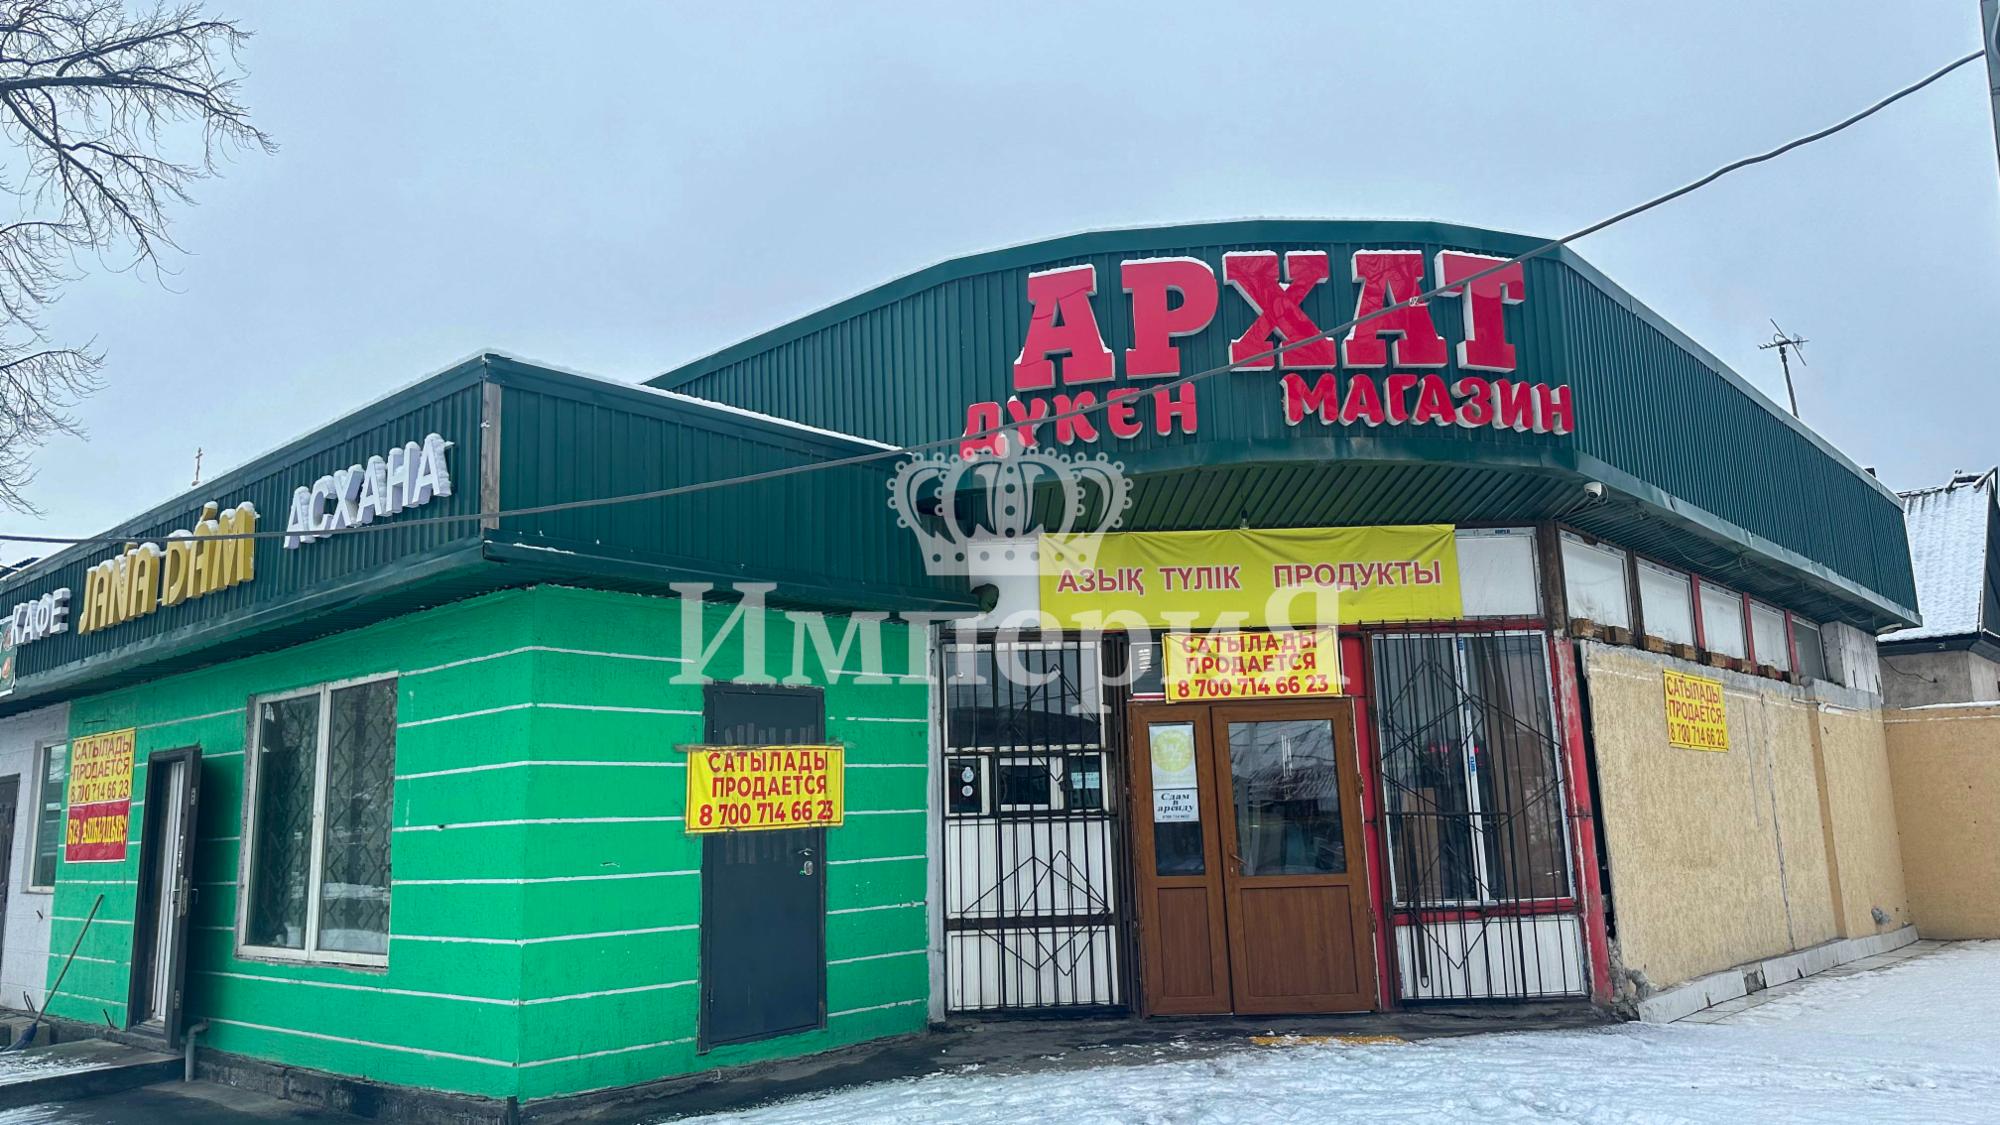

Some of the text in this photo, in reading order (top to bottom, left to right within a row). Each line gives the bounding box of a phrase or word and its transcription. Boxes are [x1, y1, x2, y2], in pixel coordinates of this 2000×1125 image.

[1013, 249, 1526, 392] АРХАТ
[1280, 372, 1574, 436] МАГАЗИН
[283, 432, 453, 550] АСХАНА
[1057, 560, 1442, 595] АЗЫҚ ТҮЛІК ПРОДУКТЫ
[10, 587, 72, 648] КАФЕ
[1182, 631, 1318, 654] САТЫЛАДЫ
[1186, 652, 1316, 675] ПРОДАЕТСЯ
[1178, 674, 1329, 698] 8 700 714 66 23
[1666, 677, 1720, 704] САТЫЛАДЫ
[1668, 700, 1723, 724] ПРОДАЕТСЯ
[1670, 722, 1725, 747] 8 700 714 66 23
[74, 735, 132, 761] САТЫЛАДЫ
[72, 757, 130, 781] ПРОДАЕТСЯ
[708, 751, 828, 774] САТЫЛАДЫ
[92, 782, 106, 800] 714
[107, 781, 117, 799] 66
[118, 779, 129, 796] 23
[712, 775, 827, 800] ПРОДАЕТСЯ
[700, 800, 834, 826] 8 700 714 66 23
